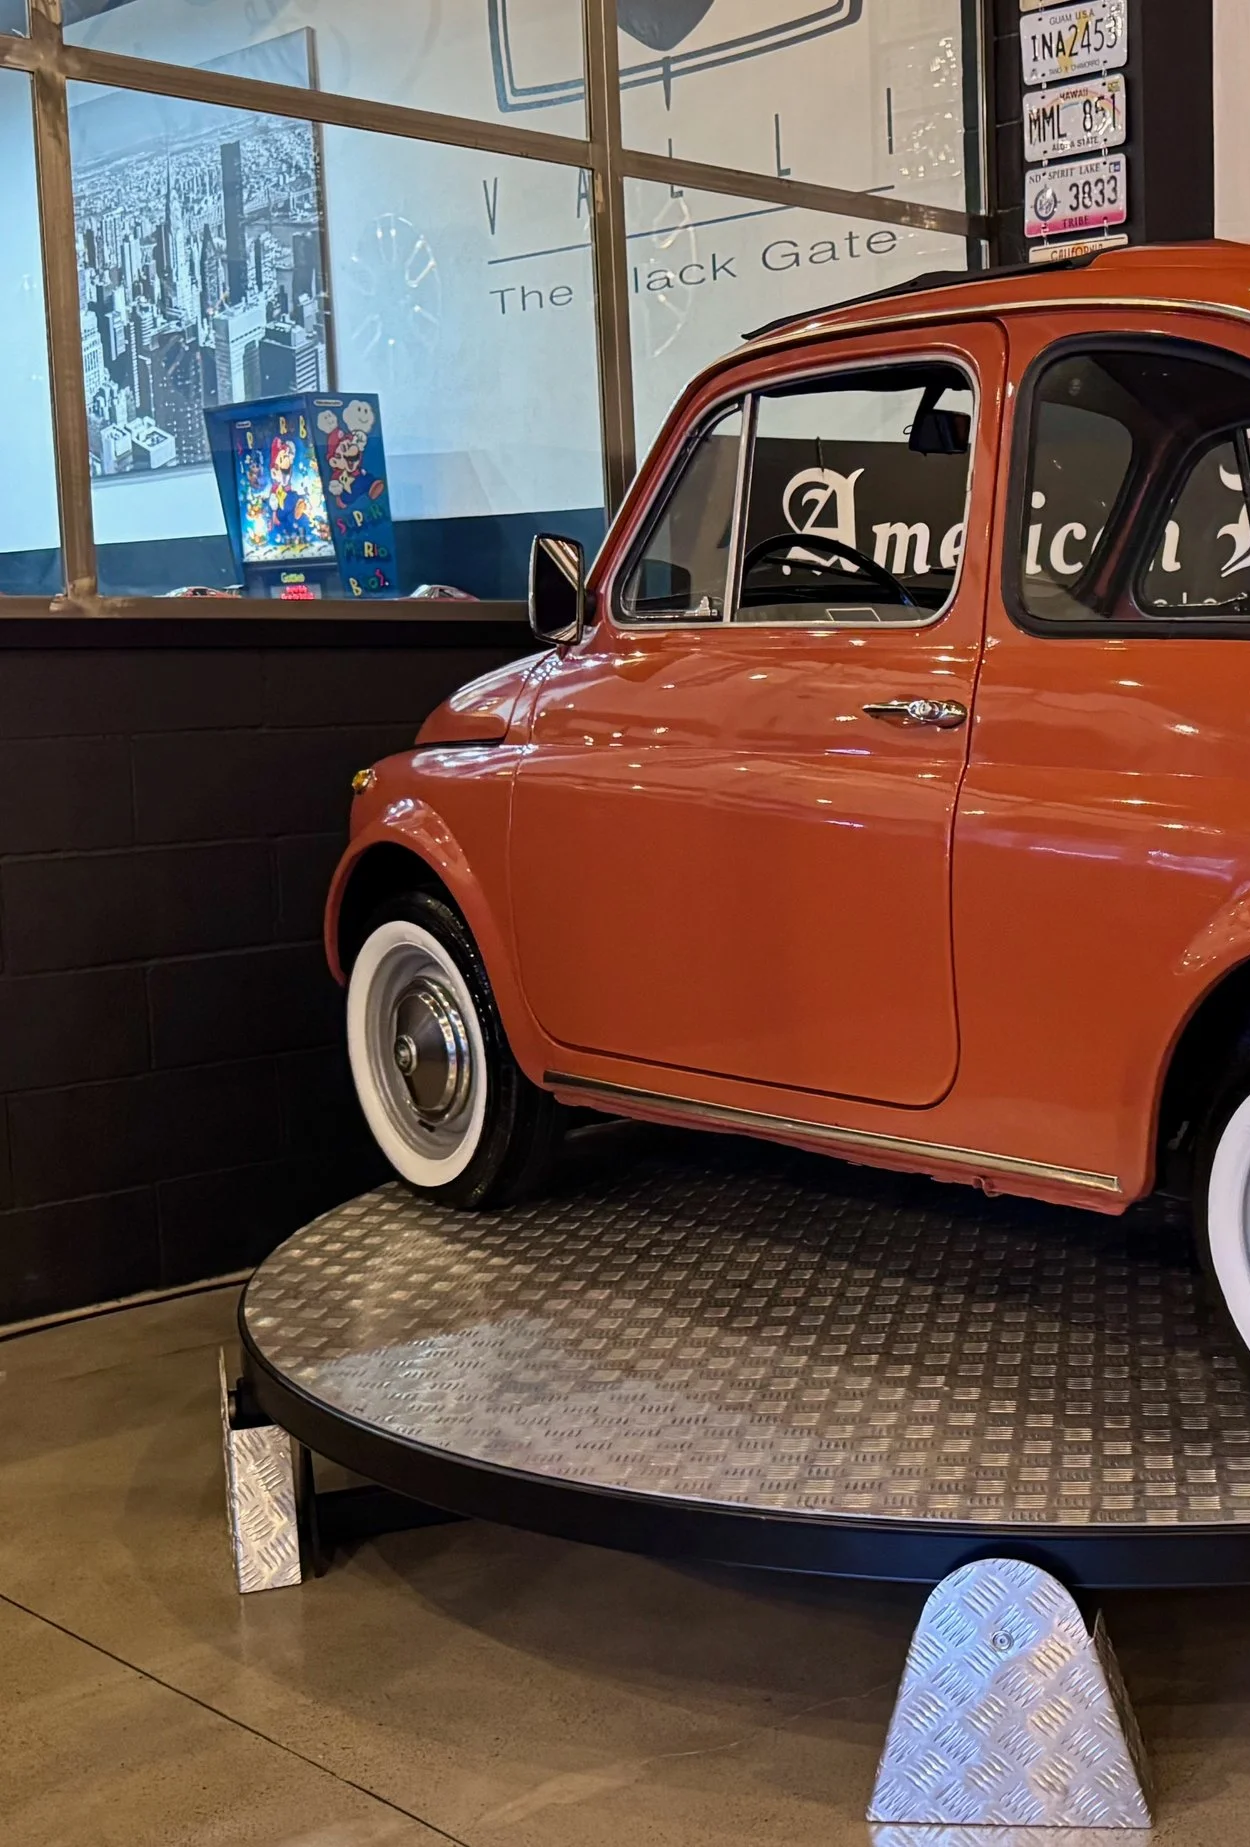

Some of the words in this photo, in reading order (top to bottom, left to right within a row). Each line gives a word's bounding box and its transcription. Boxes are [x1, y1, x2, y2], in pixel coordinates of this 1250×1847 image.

[1049, 14, 1073, 26] GUAM
[1060, 88, 1089, 101] HAWAII
[1029, 104, 1067, 145] MML
[1077, 136, 1099, 148] STATE
[1029, 174, 1041, 184] ND
[1048, 167, 1076, 180] SPIRIT
[1079, 162, 1101, 175] LAKE
[1068, 175, 1118, 212] 3833
[1063, 215, 1089, 229] TRIBE
[489, 284, 574, 316] The
[633, 252, 738, 295] lack
[761, 229, 899, 273] Gate
[781, 467, 1181, 577] Ameicn
